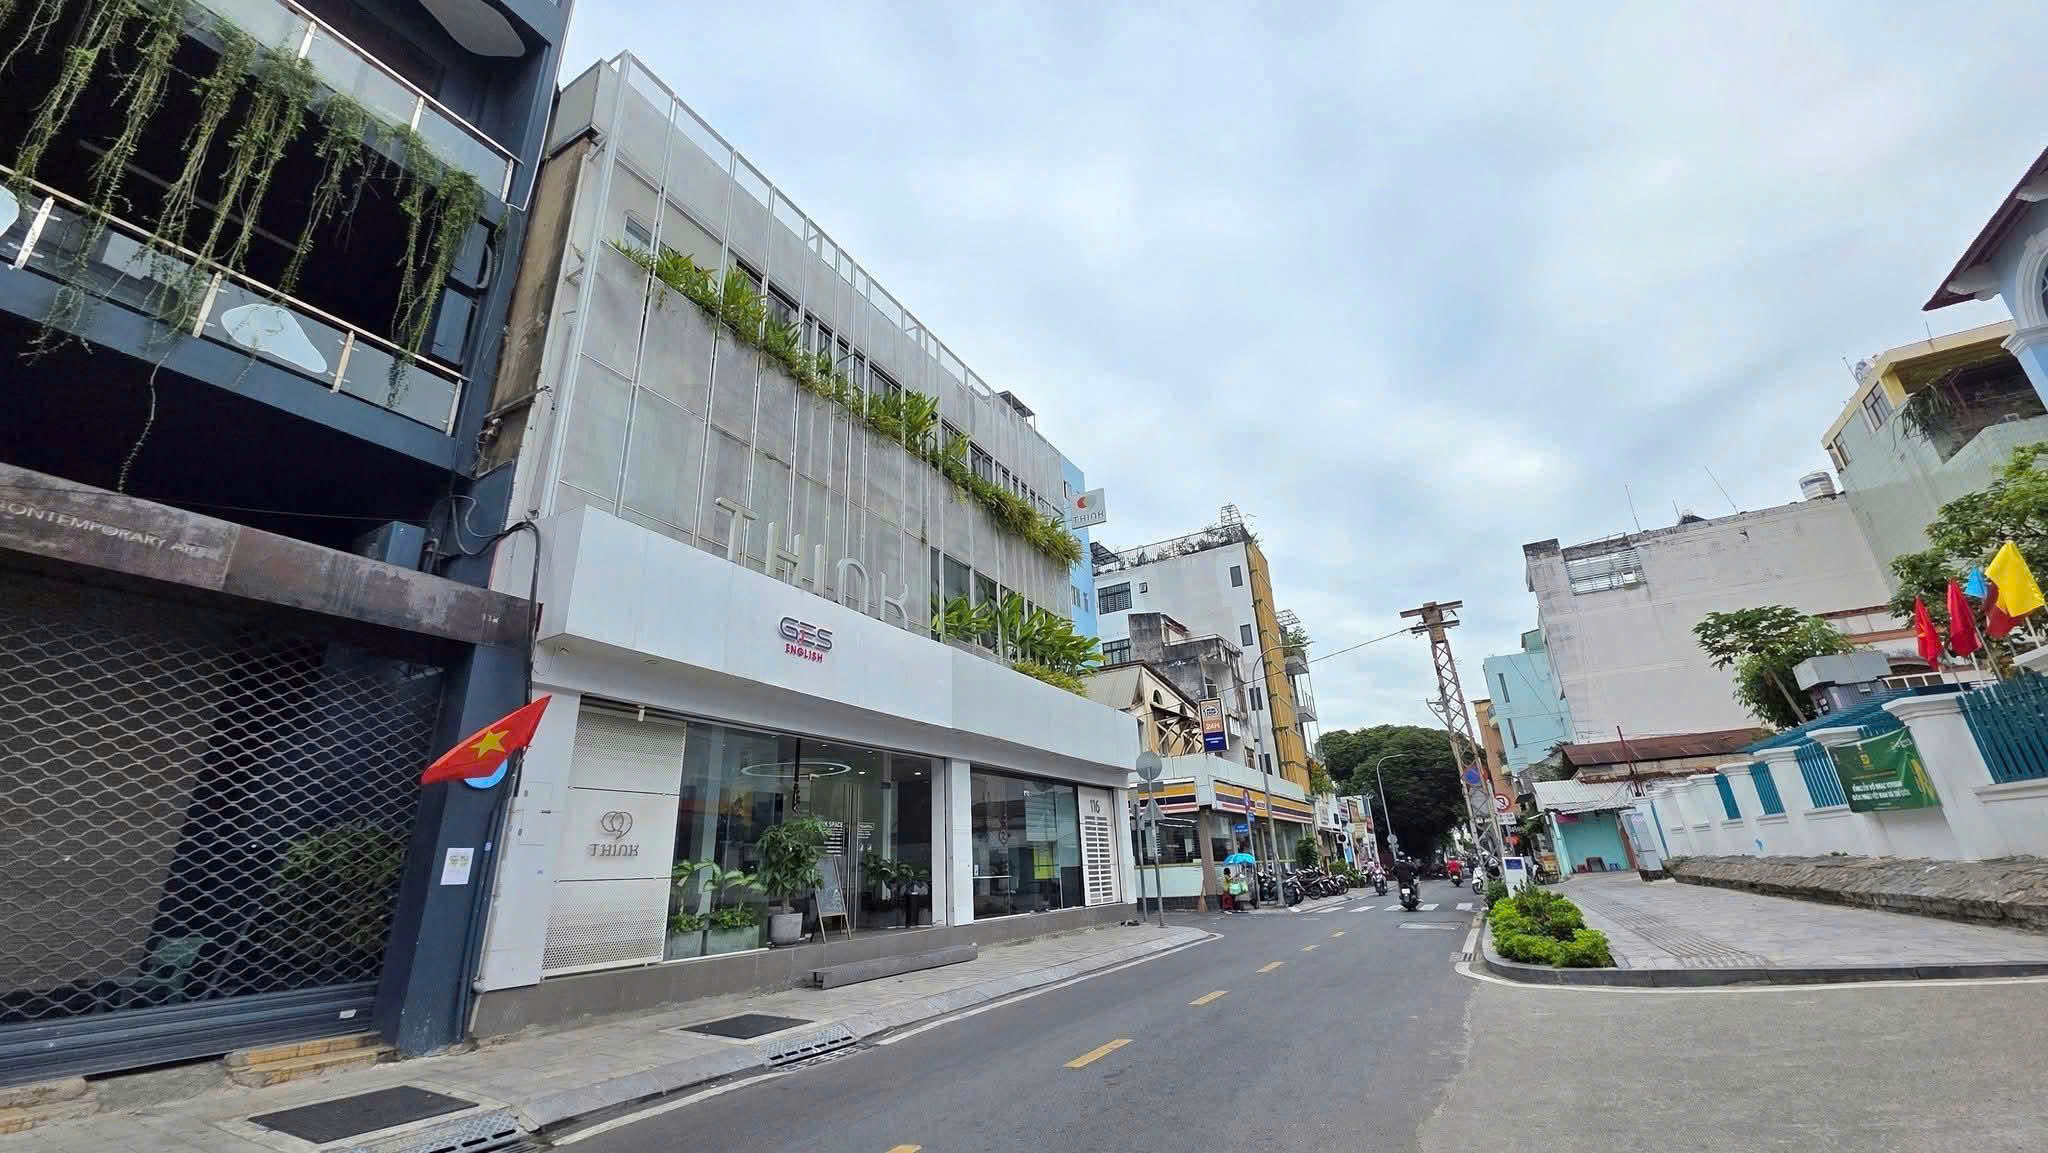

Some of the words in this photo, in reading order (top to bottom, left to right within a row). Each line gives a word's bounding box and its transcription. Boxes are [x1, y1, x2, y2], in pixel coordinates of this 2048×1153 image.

[0, 502, 167, 548] ONTEMPORARY
[1072, 509, 1105, 524] THINK
[779, 616, 833, 651] GES
[784, 643, 823, 663] ENGLISH
[1089, 799, 1101, 814] 116
[588, 843, 640, 857] THINK
